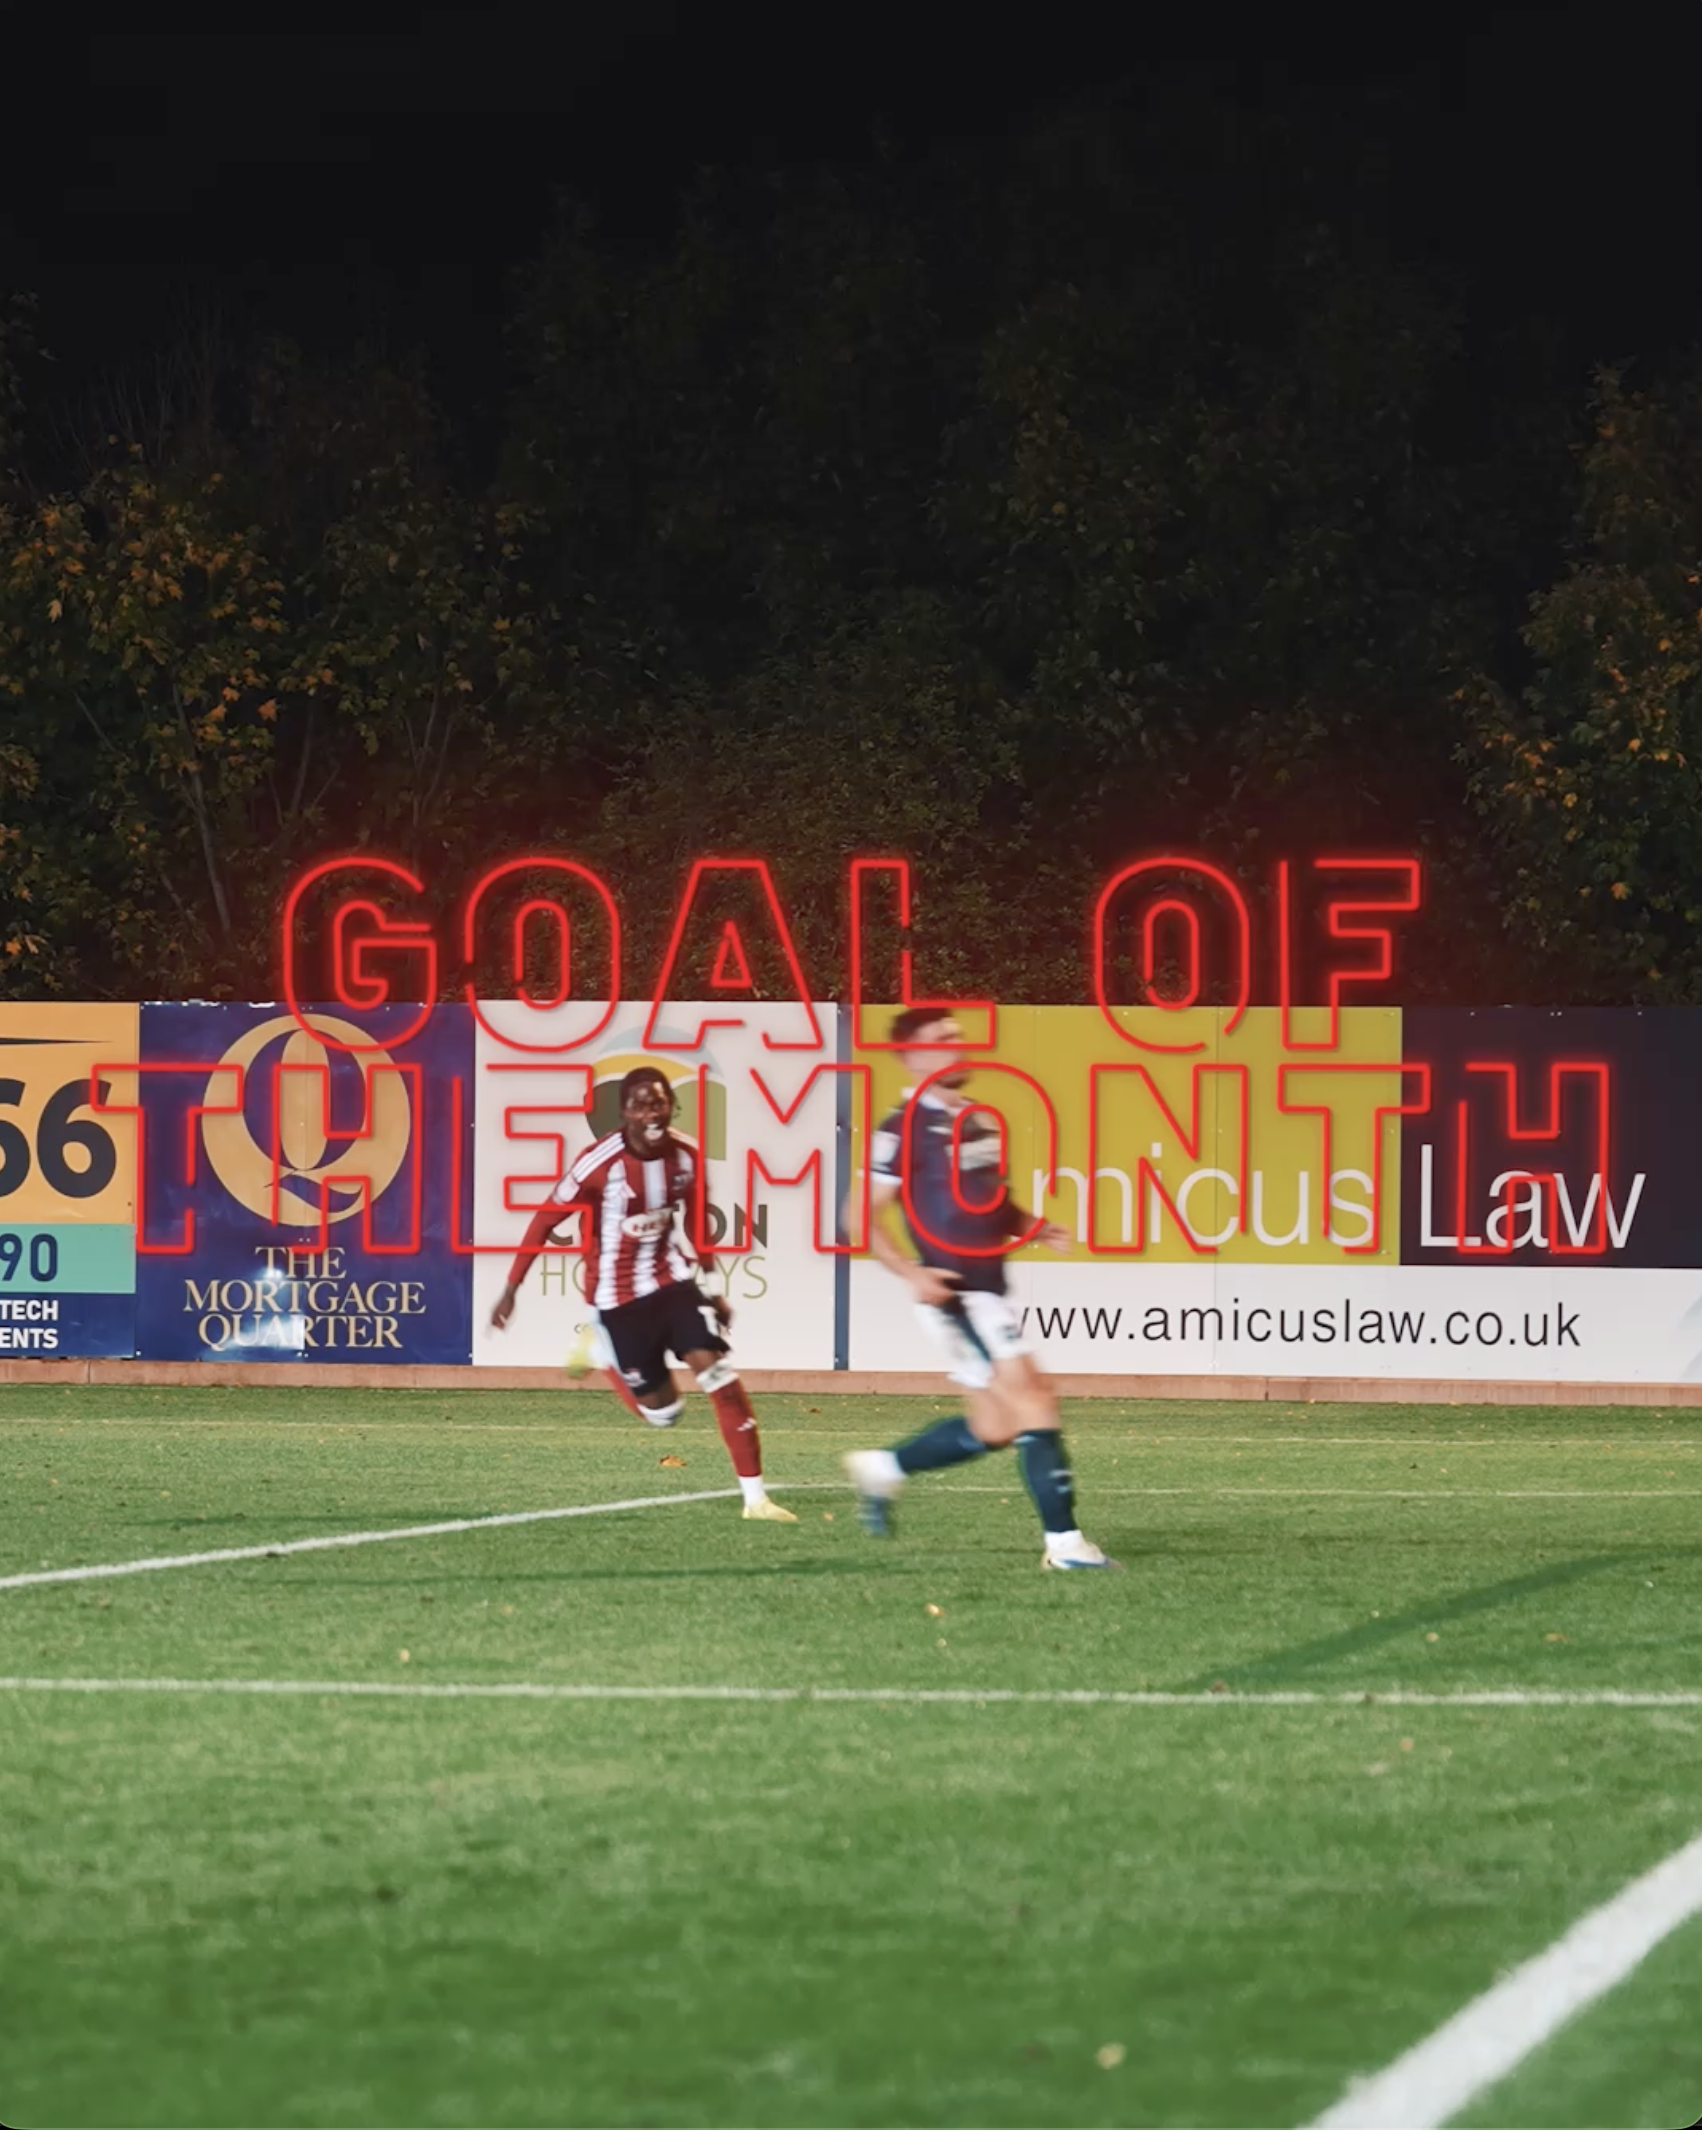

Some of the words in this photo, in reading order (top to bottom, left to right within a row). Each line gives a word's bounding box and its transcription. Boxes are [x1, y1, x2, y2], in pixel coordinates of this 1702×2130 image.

[1030, 1142, 1375, 1247] micus
[1420, 1144, 1646, 1249] Law
[0, 1233, 58, 1282] 90
[255, 1246, 347, 1280] THE
[183, 1279, 427, 1315] MORTGAGE
[198, 1313, 403, 1352] QUARTER
